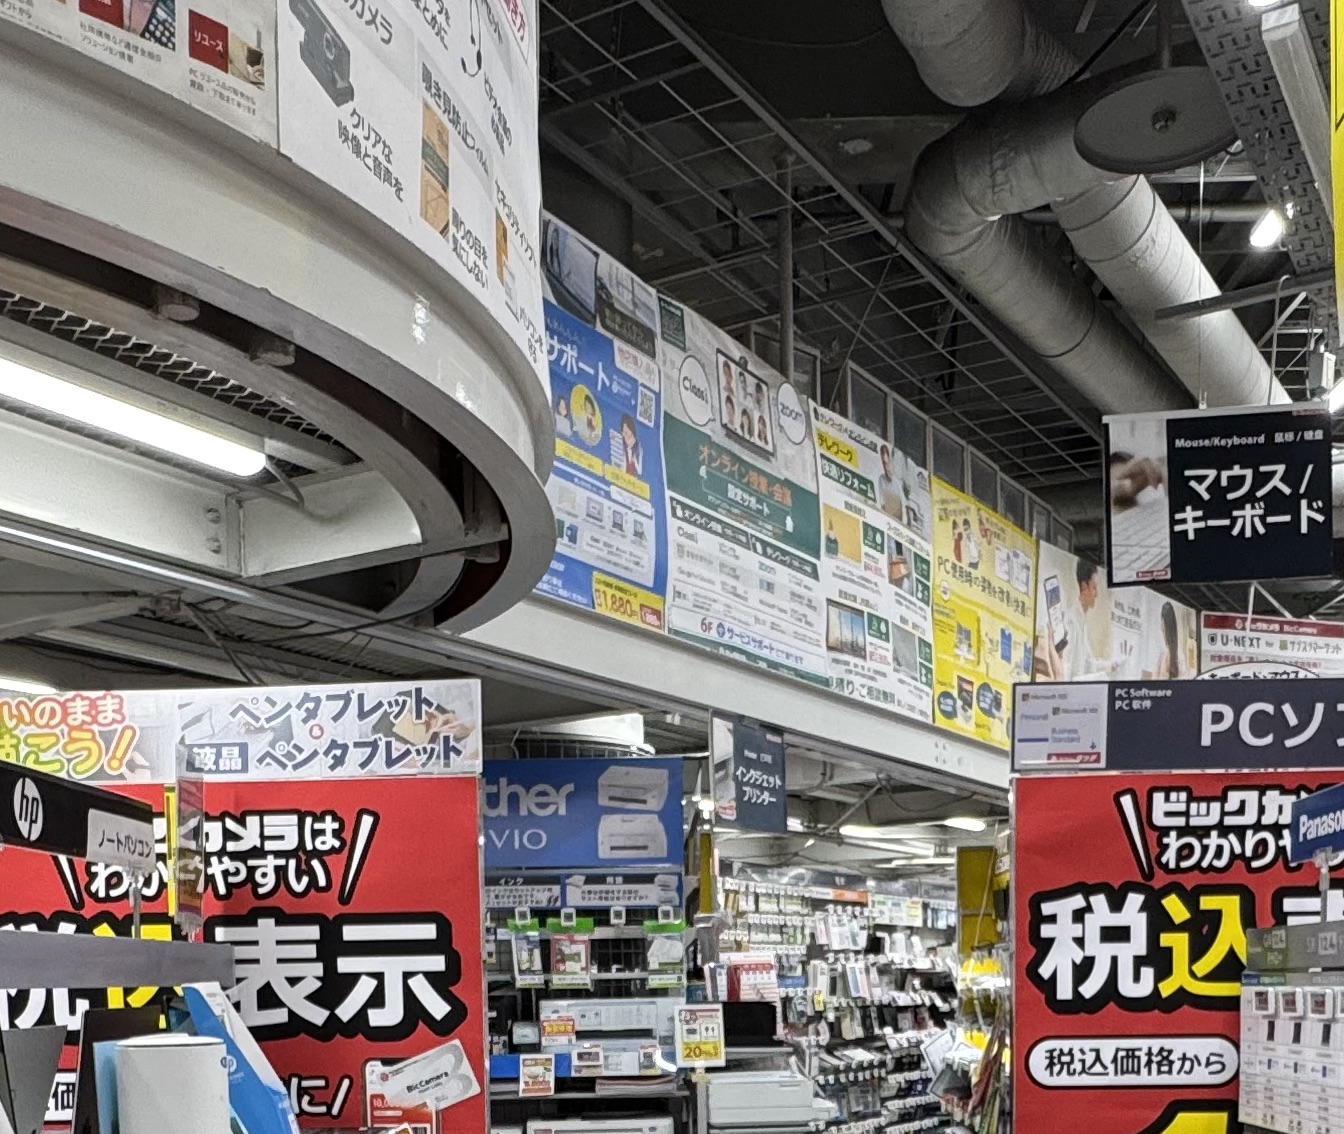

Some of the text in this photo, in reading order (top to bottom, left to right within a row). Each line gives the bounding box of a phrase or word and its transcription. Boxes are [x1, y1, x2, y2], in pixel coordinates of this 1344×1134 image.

[778, 399, 806, 425] zoom
[1174, 433, 1266, 448] Mouse/Keyboard
[1173, 498, 1326, 541] キーボード
[228, 686, 437, 724] ペンタブレット
[1114, 687, 1173, 699] PC Software
[256, 733, 464, 772] ペンタブレット
[18, 786, 40, 838] hp
[484, 777, 575, 817] ther
[96, 826, 154, 862] ノートパソコン
[1044, 1046, 1227, 1079] 税込価格から
